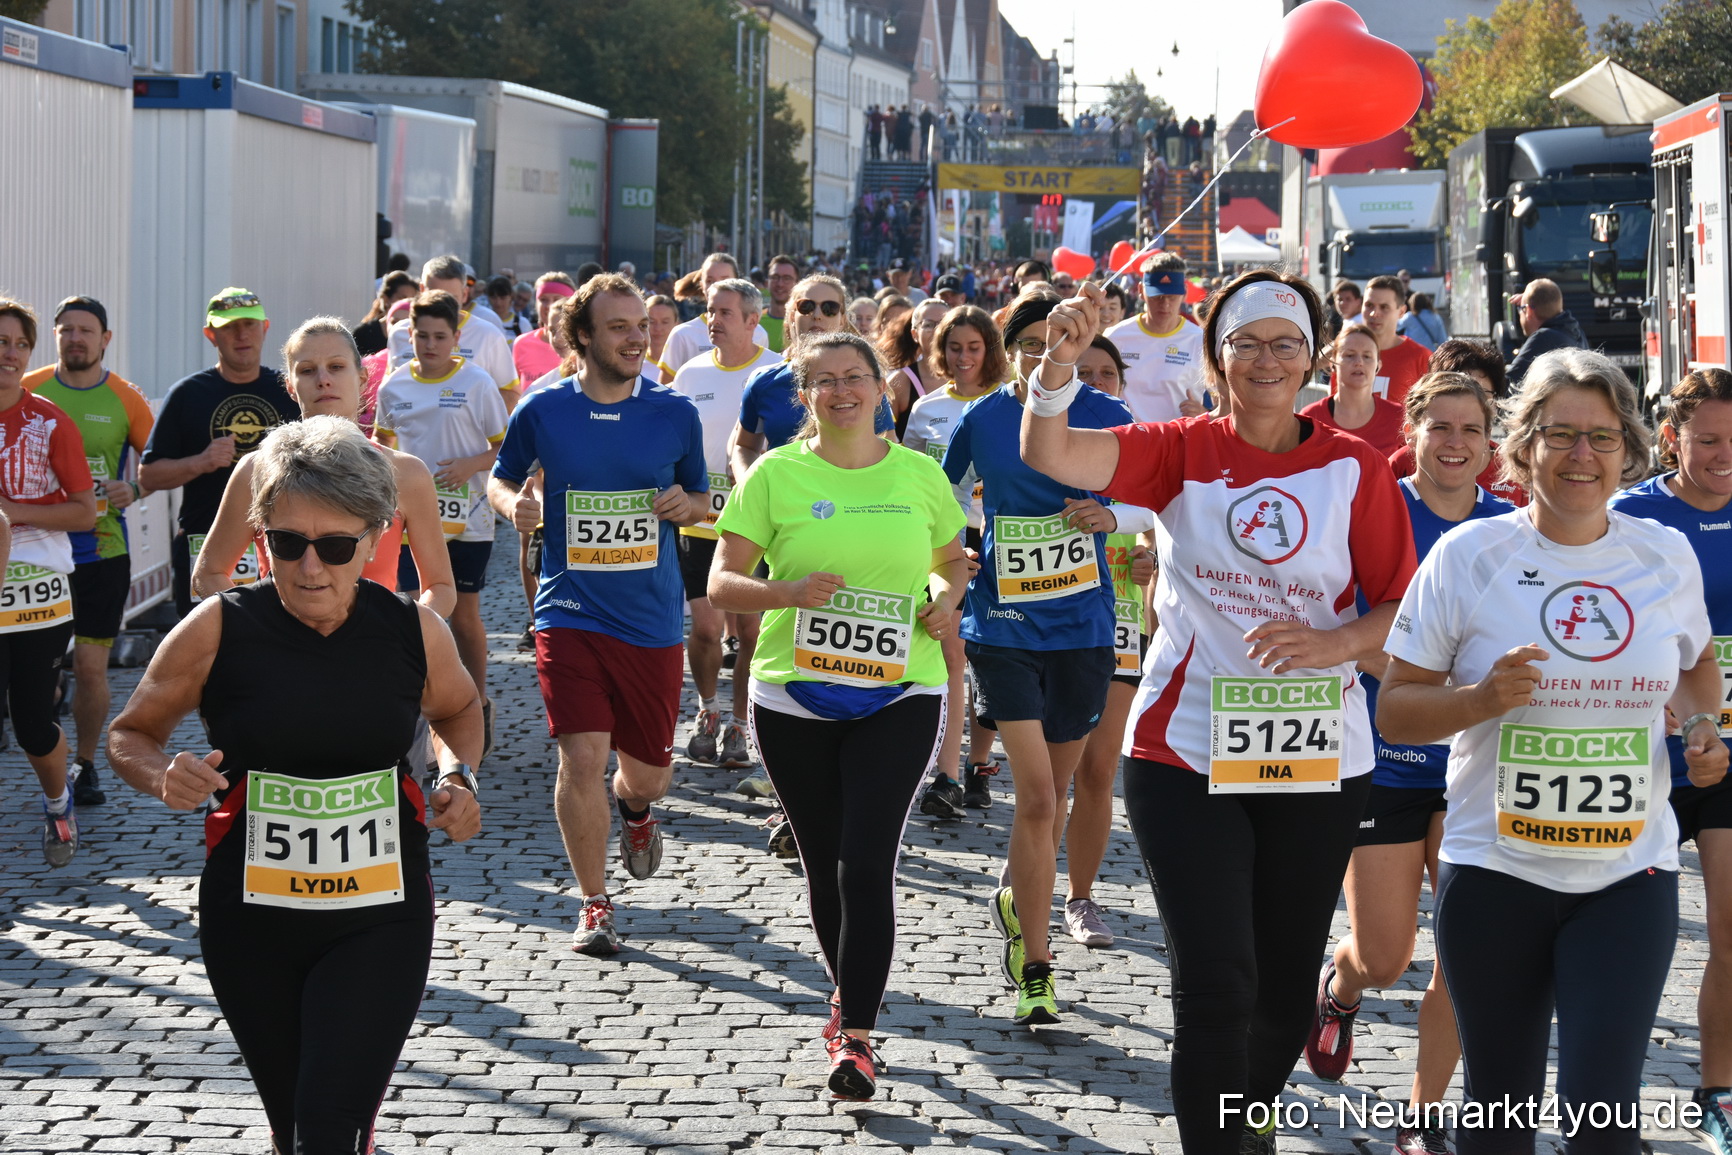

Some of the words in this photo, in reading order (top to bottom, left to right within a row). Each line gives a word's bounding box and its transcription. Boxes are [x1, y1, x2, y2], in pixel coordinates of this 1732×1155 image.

[1004, 171, 1073, 188] START
[214, 398, 276, 425] KAMPFSCHWIMMER
[590, 411, 620, 421] hummel
[573, 493, 650, 513] BOCK
[577, 518, 648, 543] 5245
[1699, 520, 1732, 531] hummel
[590, 548, 642, 565] ALBAN
[1008, 537, 1085, 573] 5176
[1, 577, 62, 607] 5199
[1020, 573, 1078, 592] REGINA
[1195, 565, 1252, 585] LAUFEN
[1287, 583, 1324, 601] HERZ
[1210, 587, 1226, 598] Dr.
[1229, 590, 1254, 602] Heck
[1265, 595, 1279, 604] Dr.
[15, 609, 56, 622] JUTTA
[990, 608, 1025, 621] medbo
[806, 617, 898, 656] 5056
[811, 656, 884, 678] CLAUDIA
[1222, 681, 1332, 708] BOCK
[1532, 679, 1581, 690] UFEN
[1591, 679, 1622, 691] MIT
[1632, 676, 1669, 692] HERZ
[1529, 699, 1546, 707] Dr.
[1551, 699, 1581, 708] Heck
[1593, 699, 1610, 709] Dr.
[1615, 698, 1653, 709] Röschl
[1227, 718, 1328, 753] 5124
[1510, 729, 1638, 762] BOCK
[1381, 748, 1427, 762] medbo
[1259, 765, 1293, 778] INA
[259, 776, 385, 814] BOCK
[1514, 772, 1632, 813] 5123
[265, 818, 377, 864] 5111
[1511, 819, 1633, 843] CHRISTINA
[290, 876, 359, 894] LYDIA
